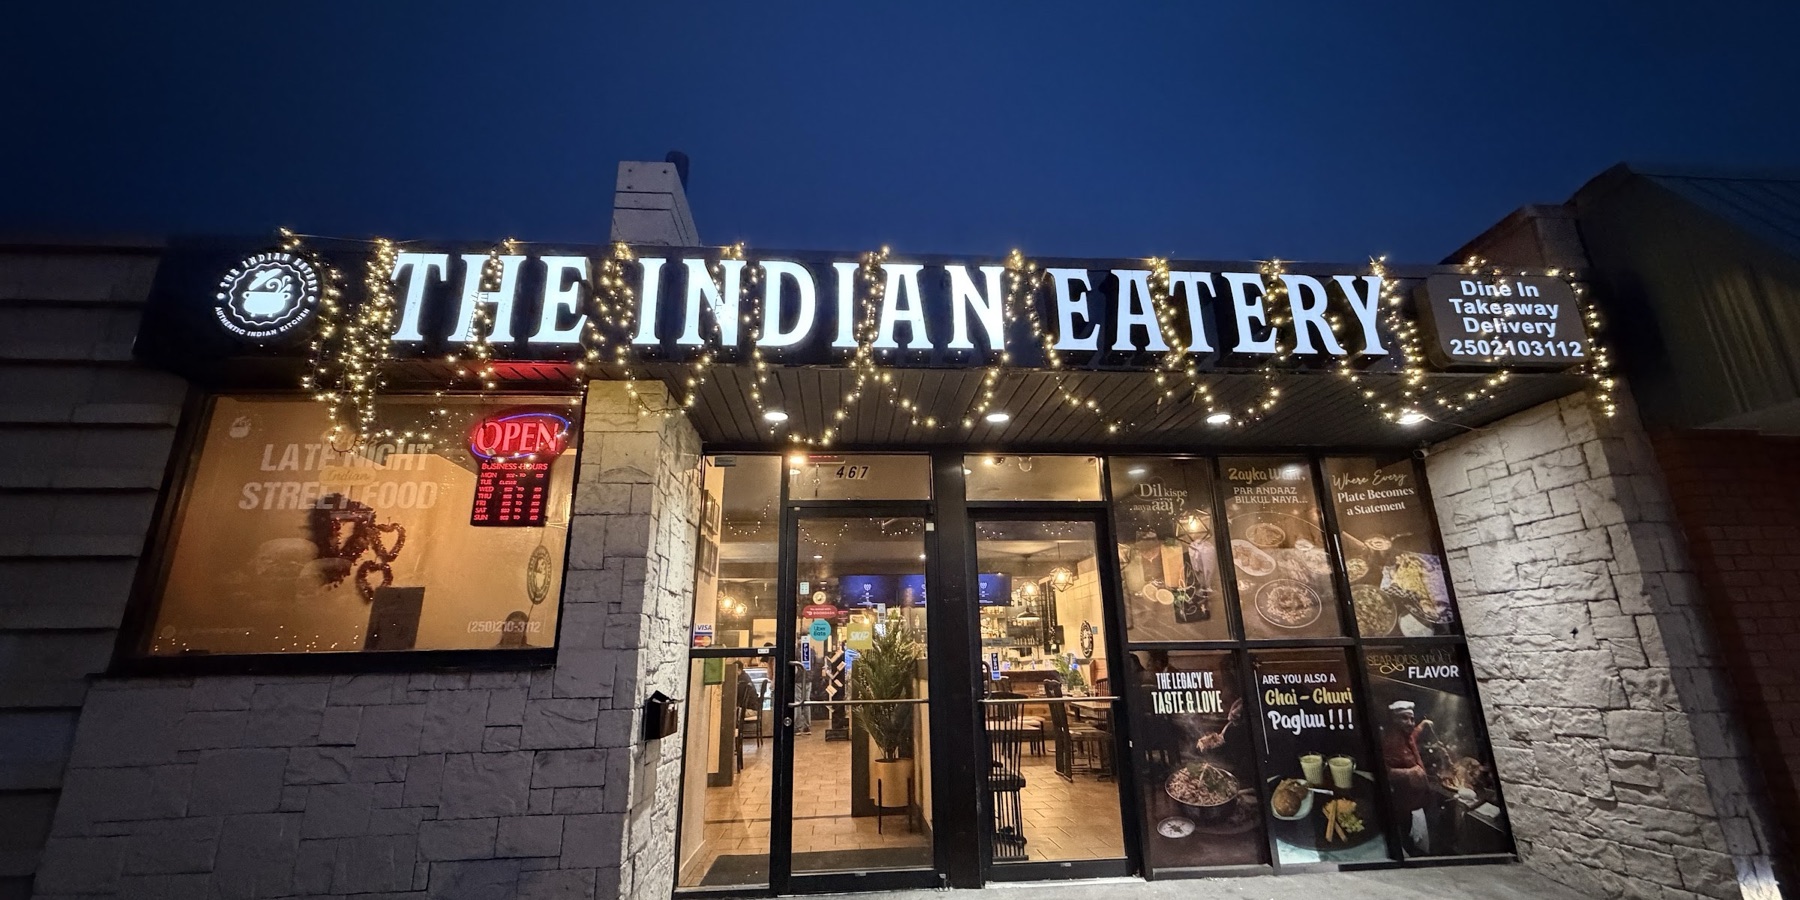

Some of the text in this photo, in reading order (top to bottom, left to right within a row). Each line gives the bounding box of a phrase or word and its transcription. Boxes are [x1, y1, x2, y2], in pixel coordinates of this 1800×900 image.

[220, 252, 318, 292] THE INDIAN EATERY
[1460, 280, 1540, 297] Dine In
[390, 253, 1389, 355] THE INDIAN EATERY
[1448, 299, 1559, 319] Takeaway
[214, 306, 310, 337] AUTHENTIC INDIAN KITCHEN
[1463, 317, 1557, 338] Delivery
[1450, 339, 1584, 357] 2502103112
[476, 422, 559, 453] OPEN
[260, 444, 434, 471] LATE NIGHT
[836, 465, 869, 479] 467
[1228, 467, 1268, 484] Zayka
[1332, 469, 1408, 490] Where Every
[238, 481, 438, 510] STREET FOOD
[1140, 483, 1188, 500] Dil kispe
[1233, 487, 1298, 495] PAR ANDAAZ
[1337, 487, 1415, 503] Plate Becomes
[1133, 504, 1151, 512] aaya
[1235, 496, 1309, 504] BILKUL NAYA...
[1346, 501, 1406, 516] a Statement
[851, 632, 869, 640] SKIP
[1155, 672, 1214, 689] THE LEGACY OF
[1262, 673, 1337, 684] ARE YOU ALSO A
[1408, 665, 1460, 679] FLAVOR
[1151, 690, 1224, 714] TASTE & LOVE
[1265, 688, 1299, 706] Chai
[1312, 686, 1355, 704] Churi
[1267, 708, 1327, 735] Pagluu
